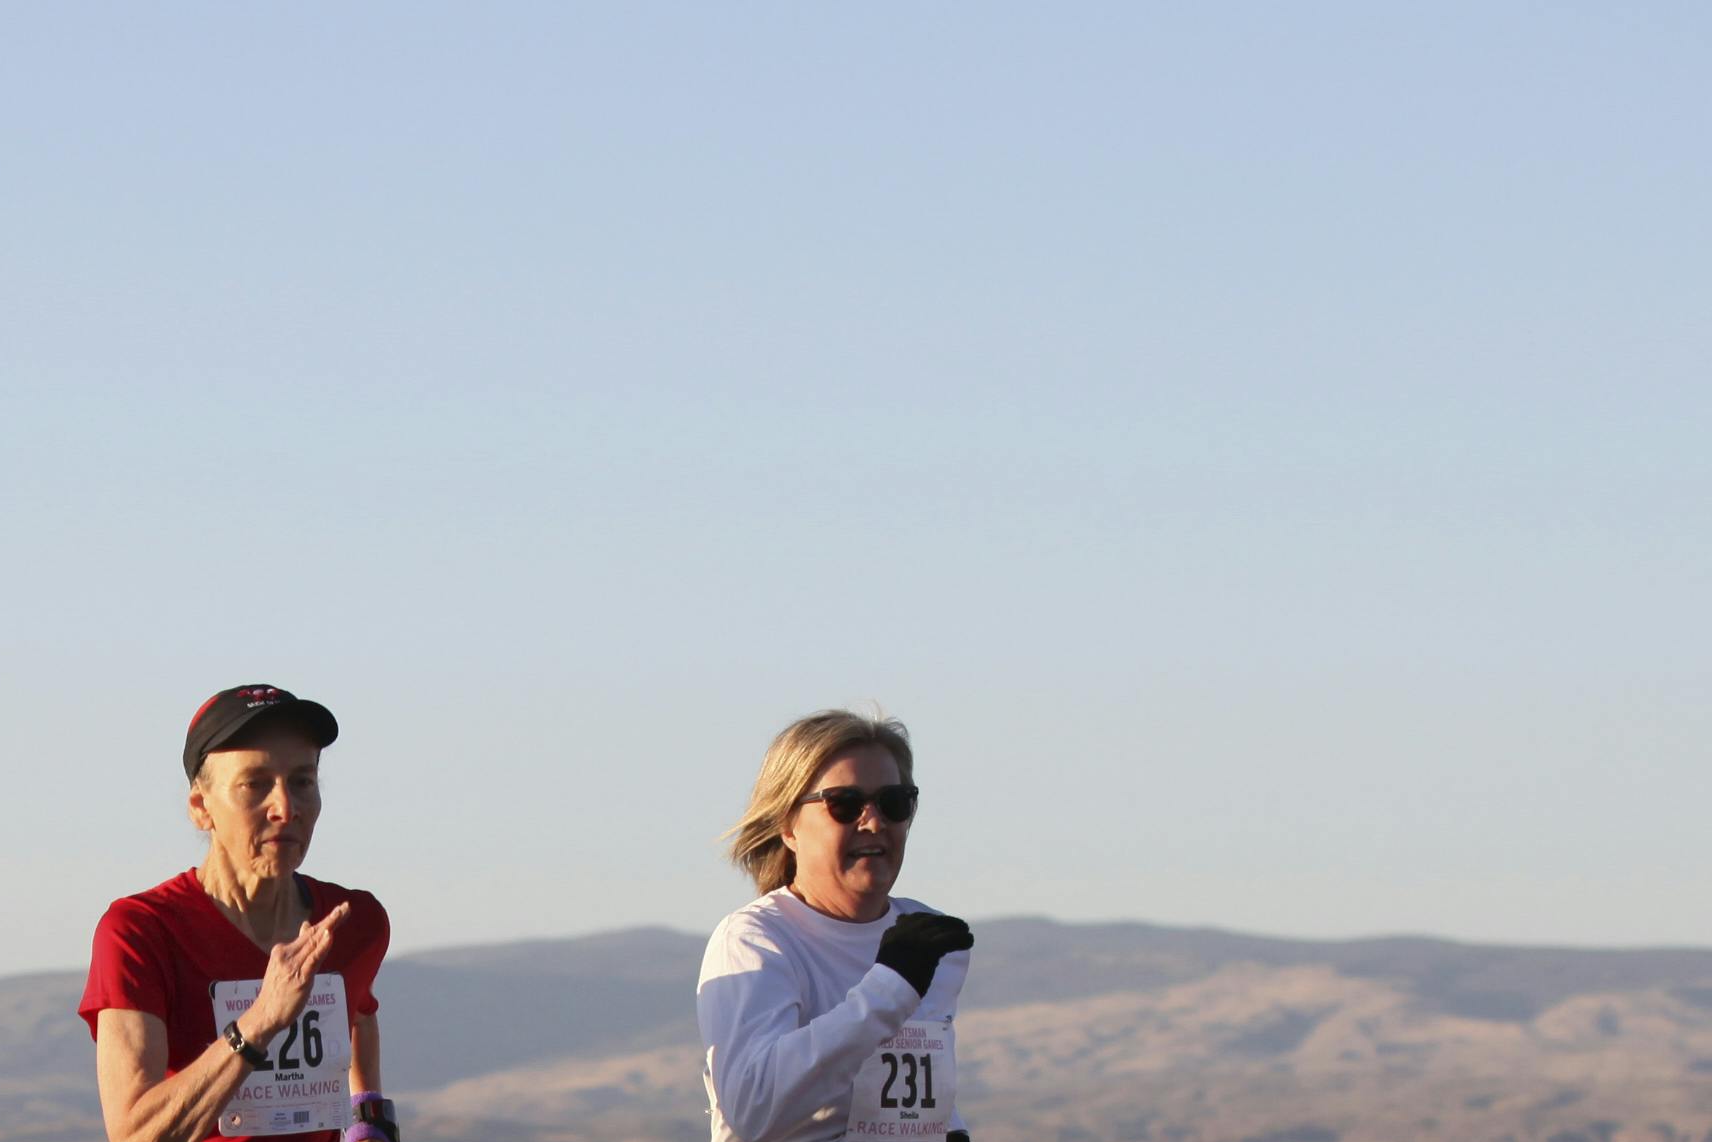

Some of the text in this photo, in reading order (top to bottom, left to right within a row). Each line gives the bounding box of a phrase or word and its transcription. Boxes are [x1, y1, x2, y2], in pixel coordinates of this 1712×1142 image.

[225, 999, 255, 1011] WOR
[254, 1010, 323, 1071] 26
[896, 1039, 922, 1048] SENIOR
[275, 1072, 304, 1081] Martha
[881, 1053, 936, 1108] 231
[278, 1080, 340, 1098] WALKING
[857, 1121, 944, 1135] RACE WALKING
